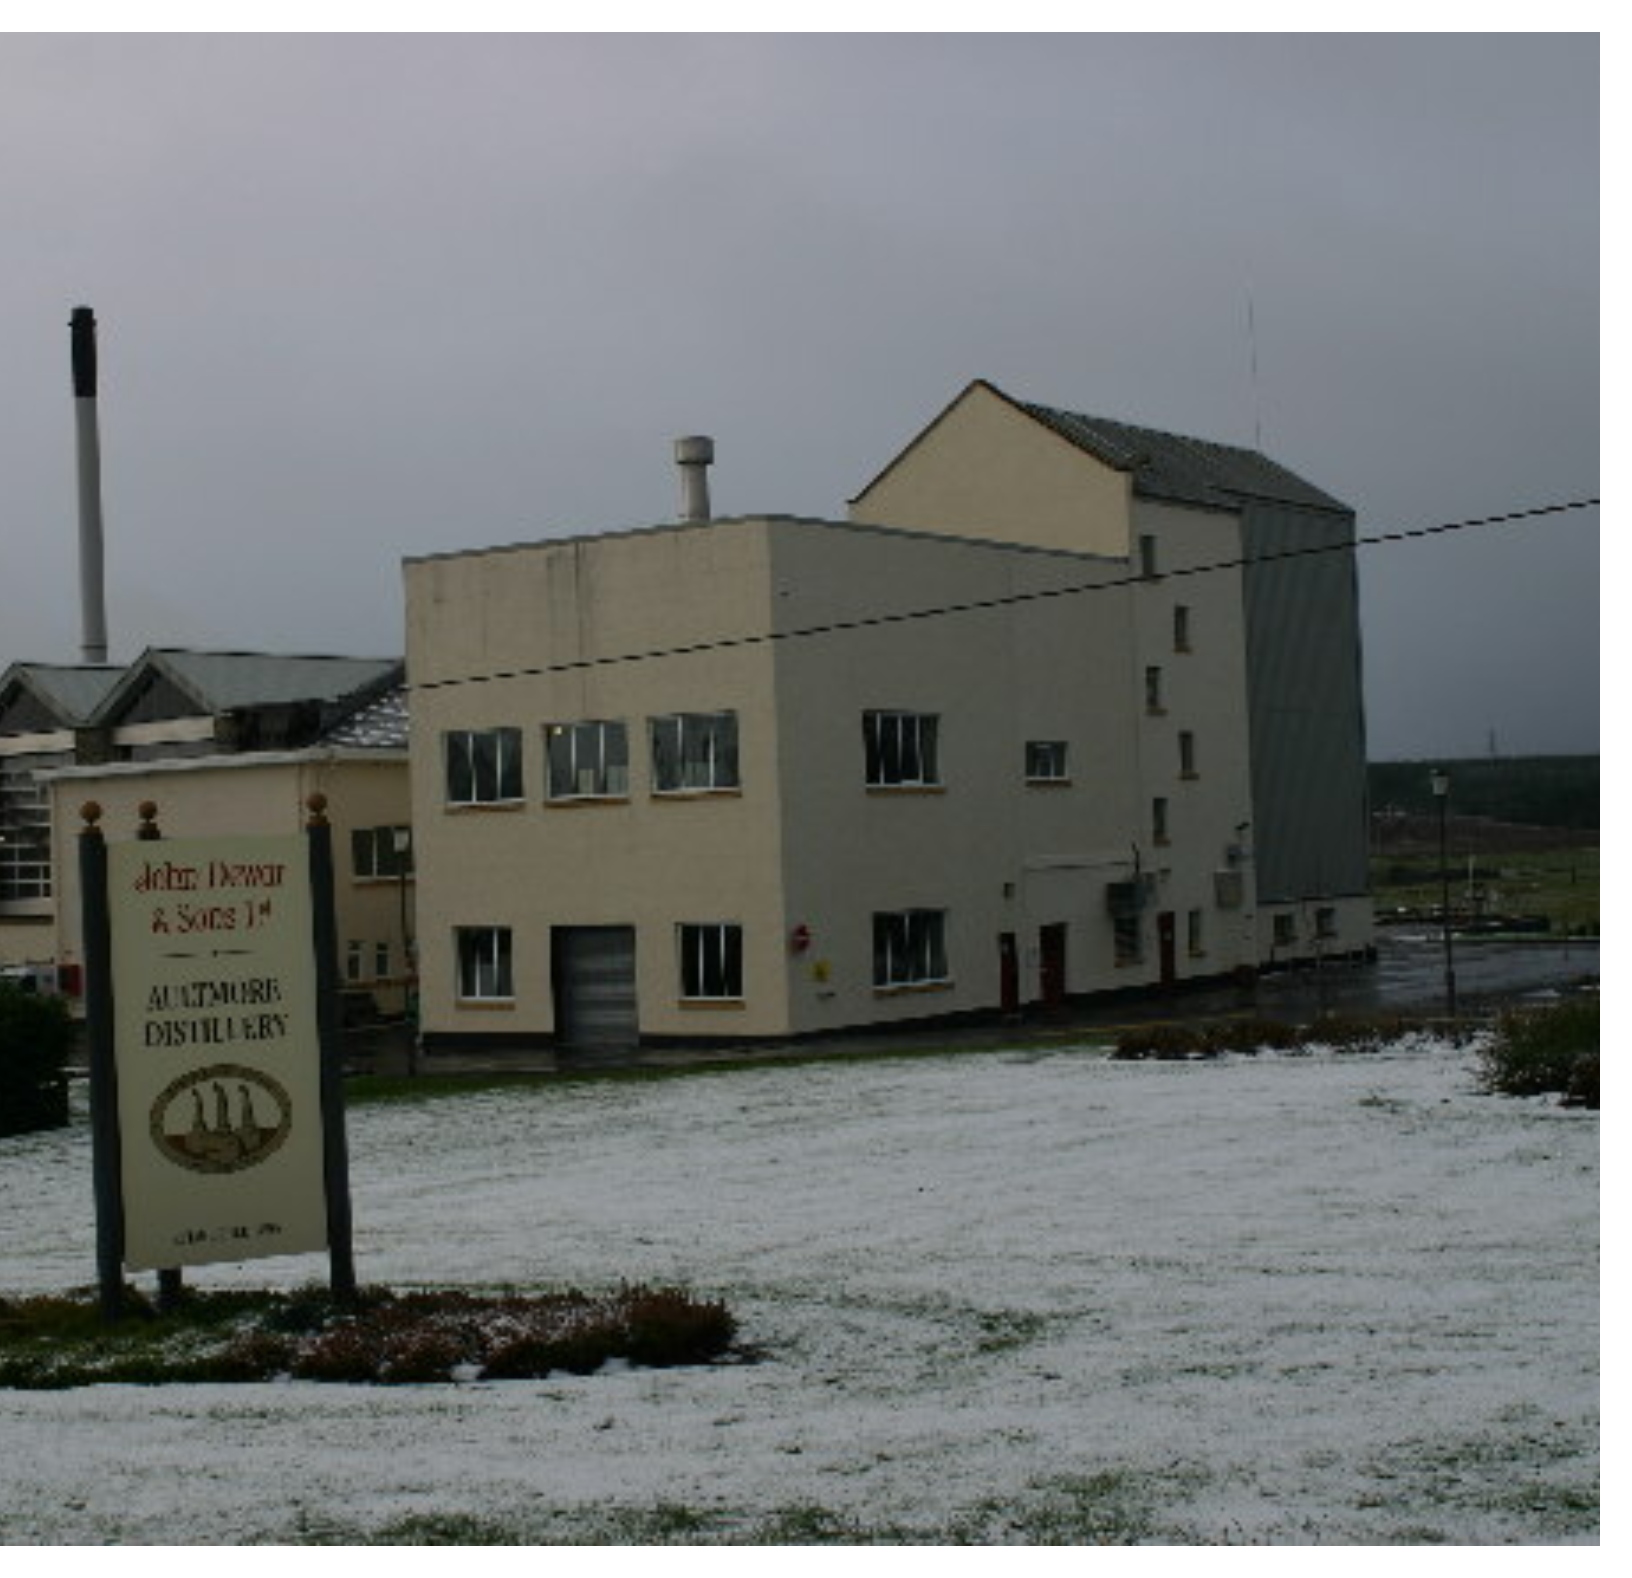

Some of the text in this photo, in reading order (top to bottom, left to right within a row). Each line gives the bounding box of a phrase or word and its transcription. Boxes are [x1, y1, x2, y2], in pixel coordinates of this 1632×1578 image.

[133, 861, 285, 892] John Dewar
[152, 907, 169, 934] &
[177, 903, 236, 933] Sons
[147, 978, 282, 1013] AULTMORE
[145, 1014, 289, 1047] DISTILLERY
